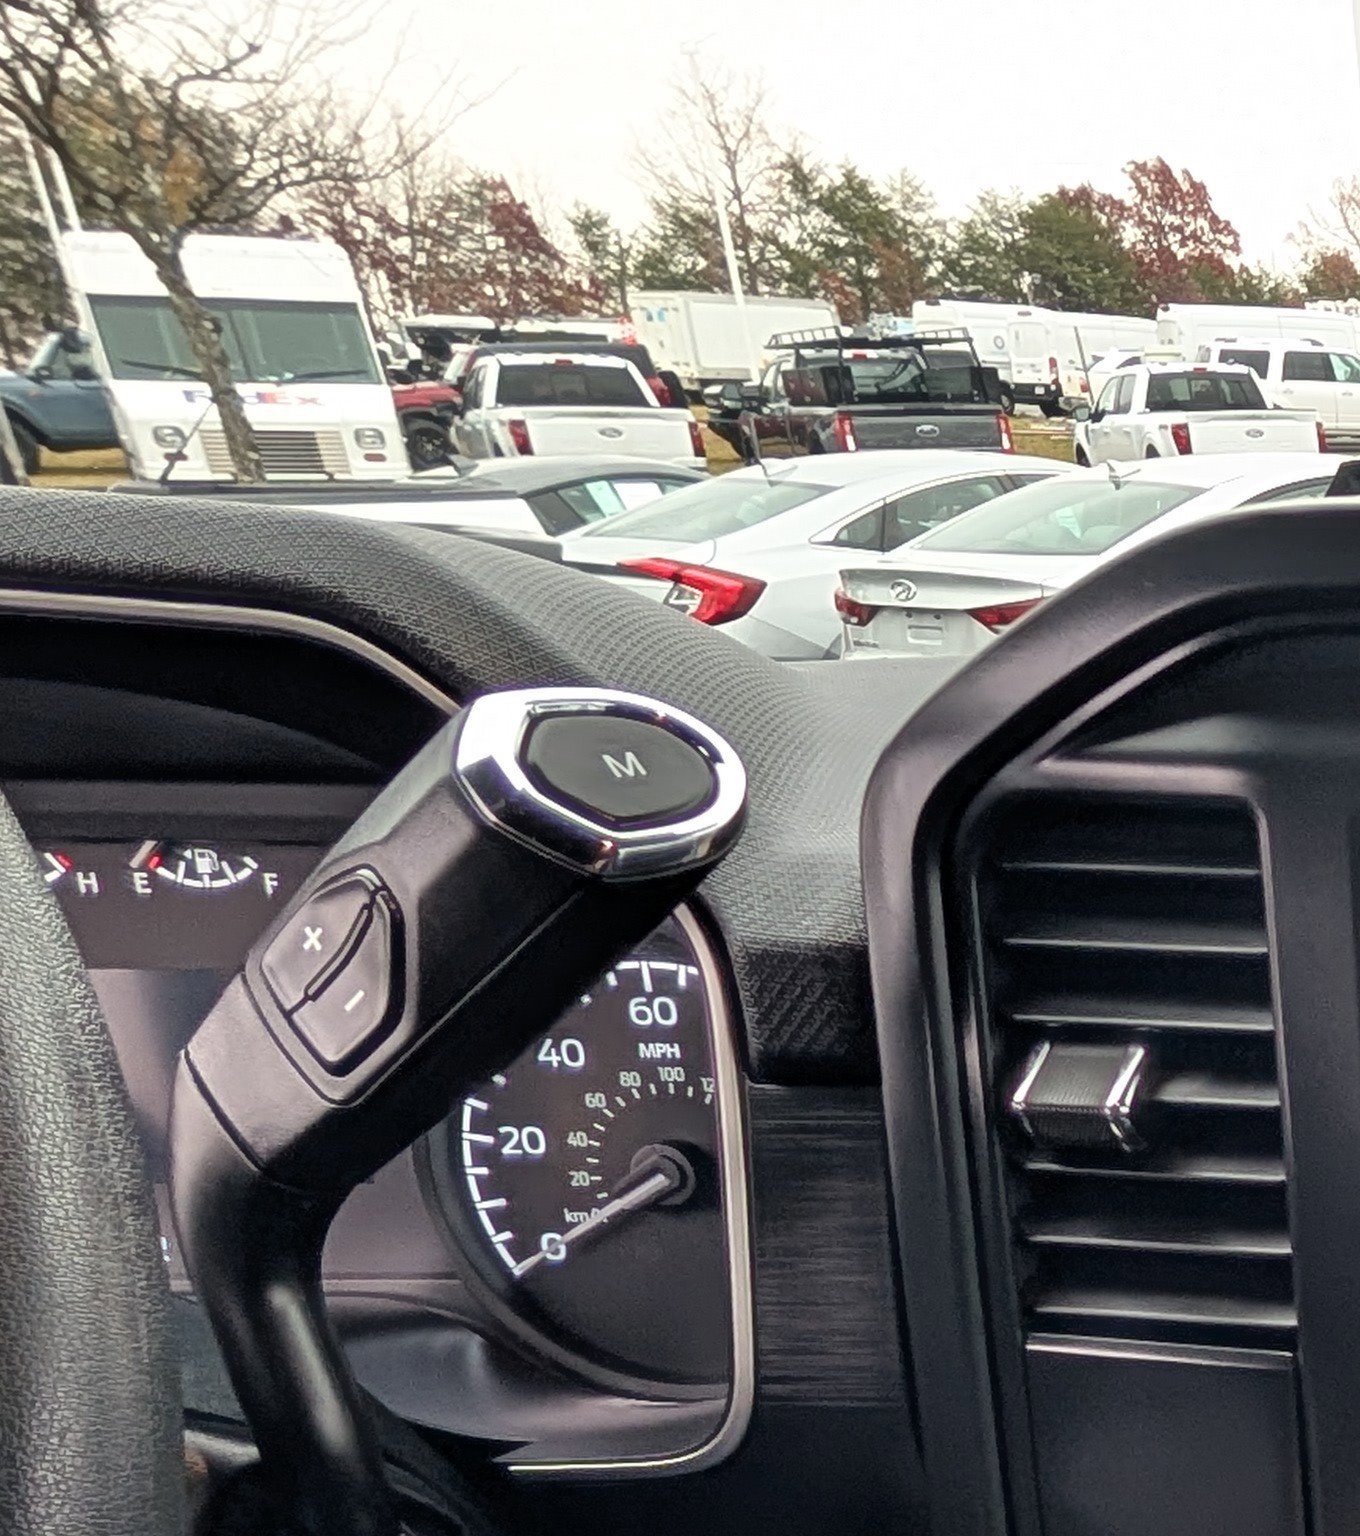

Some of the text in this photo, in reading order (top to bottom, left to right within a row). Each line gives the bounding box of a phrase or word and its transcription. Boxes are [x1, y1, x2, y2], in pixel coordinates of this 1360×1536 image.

[182, 390, 323, 406] FdEx
[601, 751, 648, 778] M
[76, 871, 99, 894] H
[132, 872, 153, 894] E
[263, 872, 279, 895] F
[628, 996, 678, 1026] 60
[537, 1038, 586, 1068] 40
[638, 1043, 682, 1059] MPH
[619, 1071, 642, 1087] 80
[657, 1066, 686, 1083] 100
[584, 1092, 608, 1109] 60
[498, 1126, 547, 1156] 20
[566, 1131, 589, 1148] 40
[569, 1171, 591, 1188] 20
